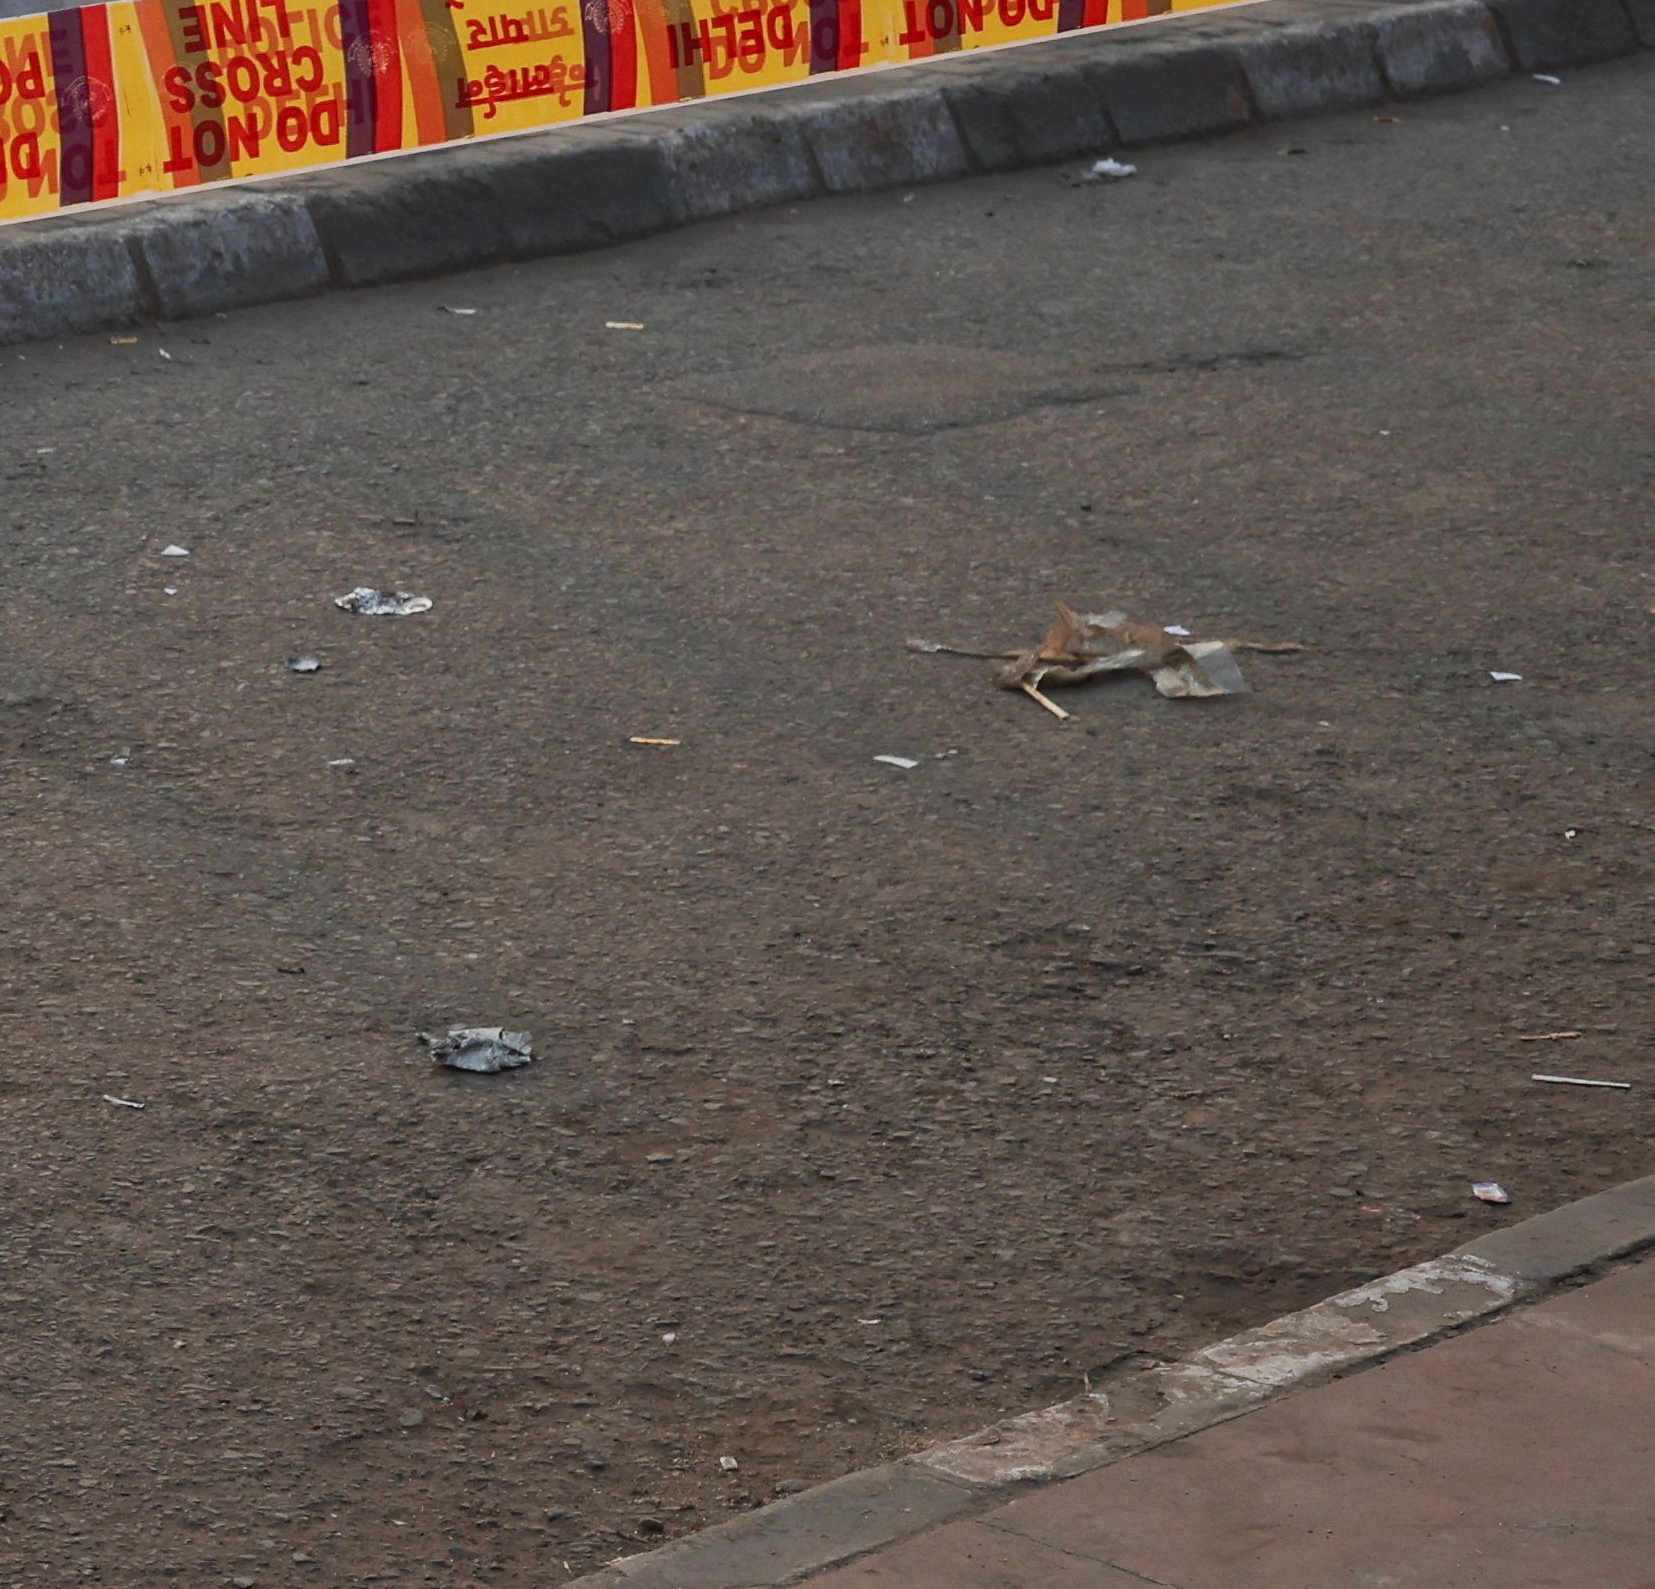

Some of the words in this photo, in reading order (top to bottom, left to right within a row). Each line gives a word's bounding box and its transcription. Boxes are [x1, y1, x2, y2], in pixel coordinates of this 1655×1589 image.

[466, 14, 529, 51] पार
[666, 5, 794, 70] DELHI
[164, 45, 324, 113] CROSS
[455, 64, 555, 120] लाईन
[163, 113, 260, 174] NOT
[276, 99, 340, 153] DO
